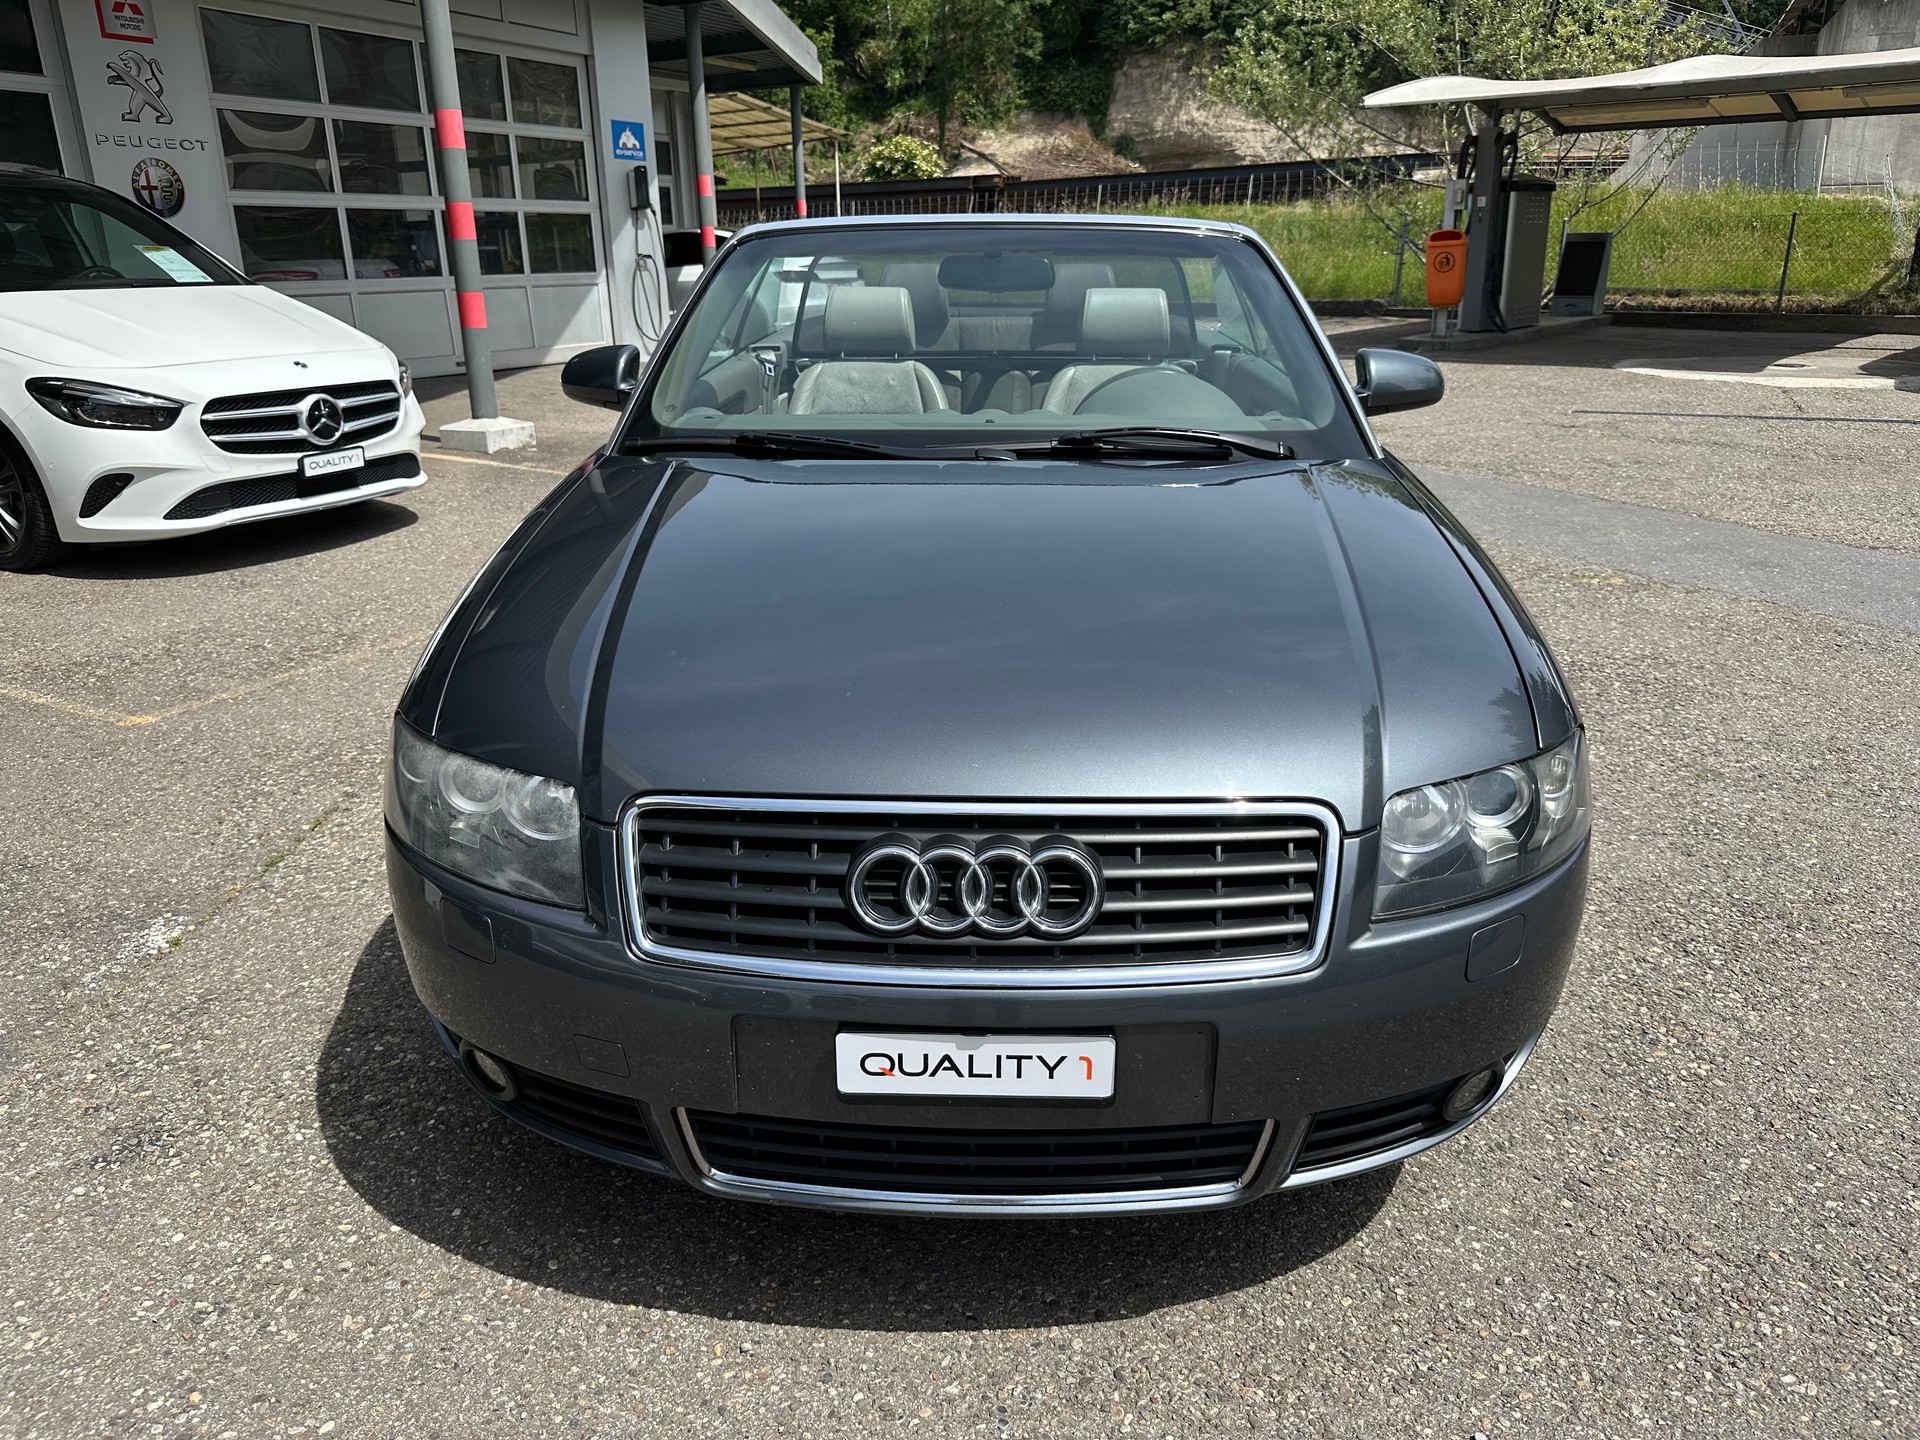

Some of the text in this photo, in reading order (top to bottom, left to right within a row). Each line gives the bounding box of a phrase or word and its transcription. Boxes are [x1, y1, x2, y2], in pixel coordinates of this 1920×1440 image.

[114, 14, 144, 24] MITSUBISHI
[120, 23, 142, 31] MOTORS
[95, 133, 209, 151] PEUGEOT
[133, 159, 183, 189] ALFA ROMEO
[309, 454, 354, 470] QUALITY
[859, 1052, 1093, 1080] QUALITY 1
